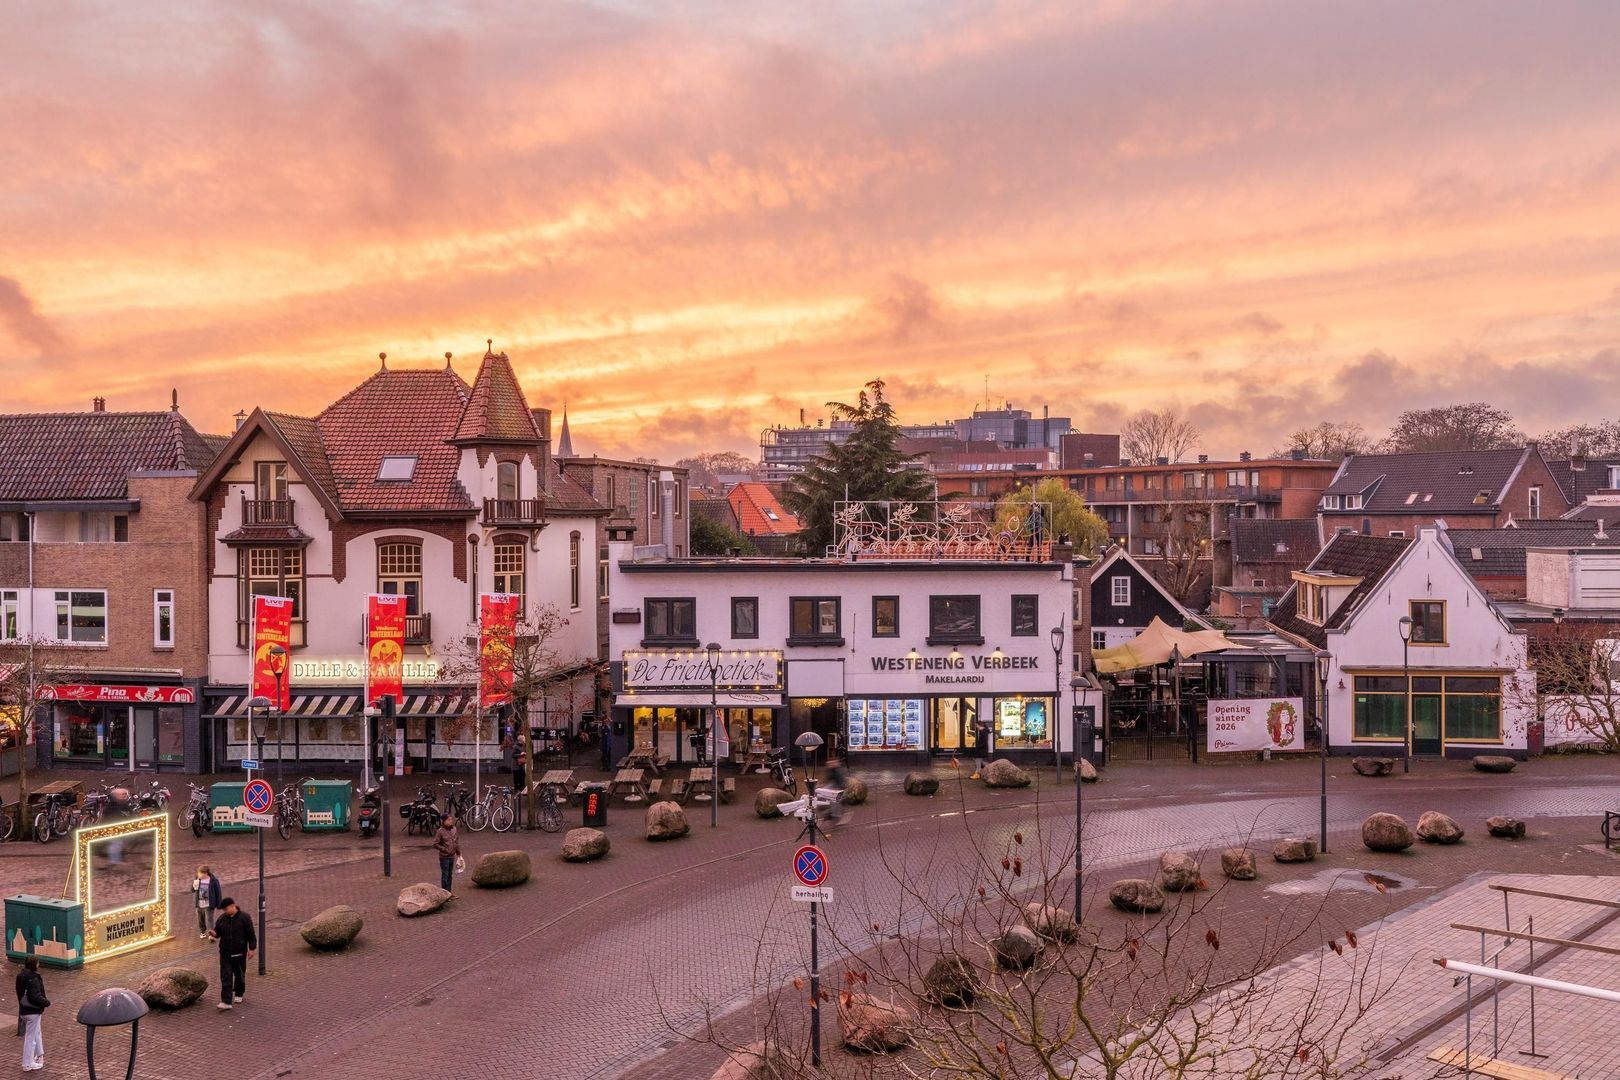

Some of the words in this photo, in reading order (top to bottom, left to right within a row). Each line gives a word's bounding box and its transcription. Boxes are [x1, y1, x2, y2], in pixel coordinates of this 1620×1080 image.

[872, 656, 965, 670] WESTENENG
[971, 655, 1039, 669] VERBEEK
[294, 663, 341, 677] DILLE
[346, 663, 358, 677] &
[631, 658, 657, 684] De
[925, 675, 985, 684] MAKELAARDIJ
[100, 687, 126, 696] Pino
[1215, 705, 1250, 715] Opening
[1215, 714, 1245, 722] winter
[796, 891, 828, 899] herhaling
[106, 919, 135, 933] WELKOM
[138, 916, 144, 924] IN
[107, 925, 144, 941] HILVERSUM
